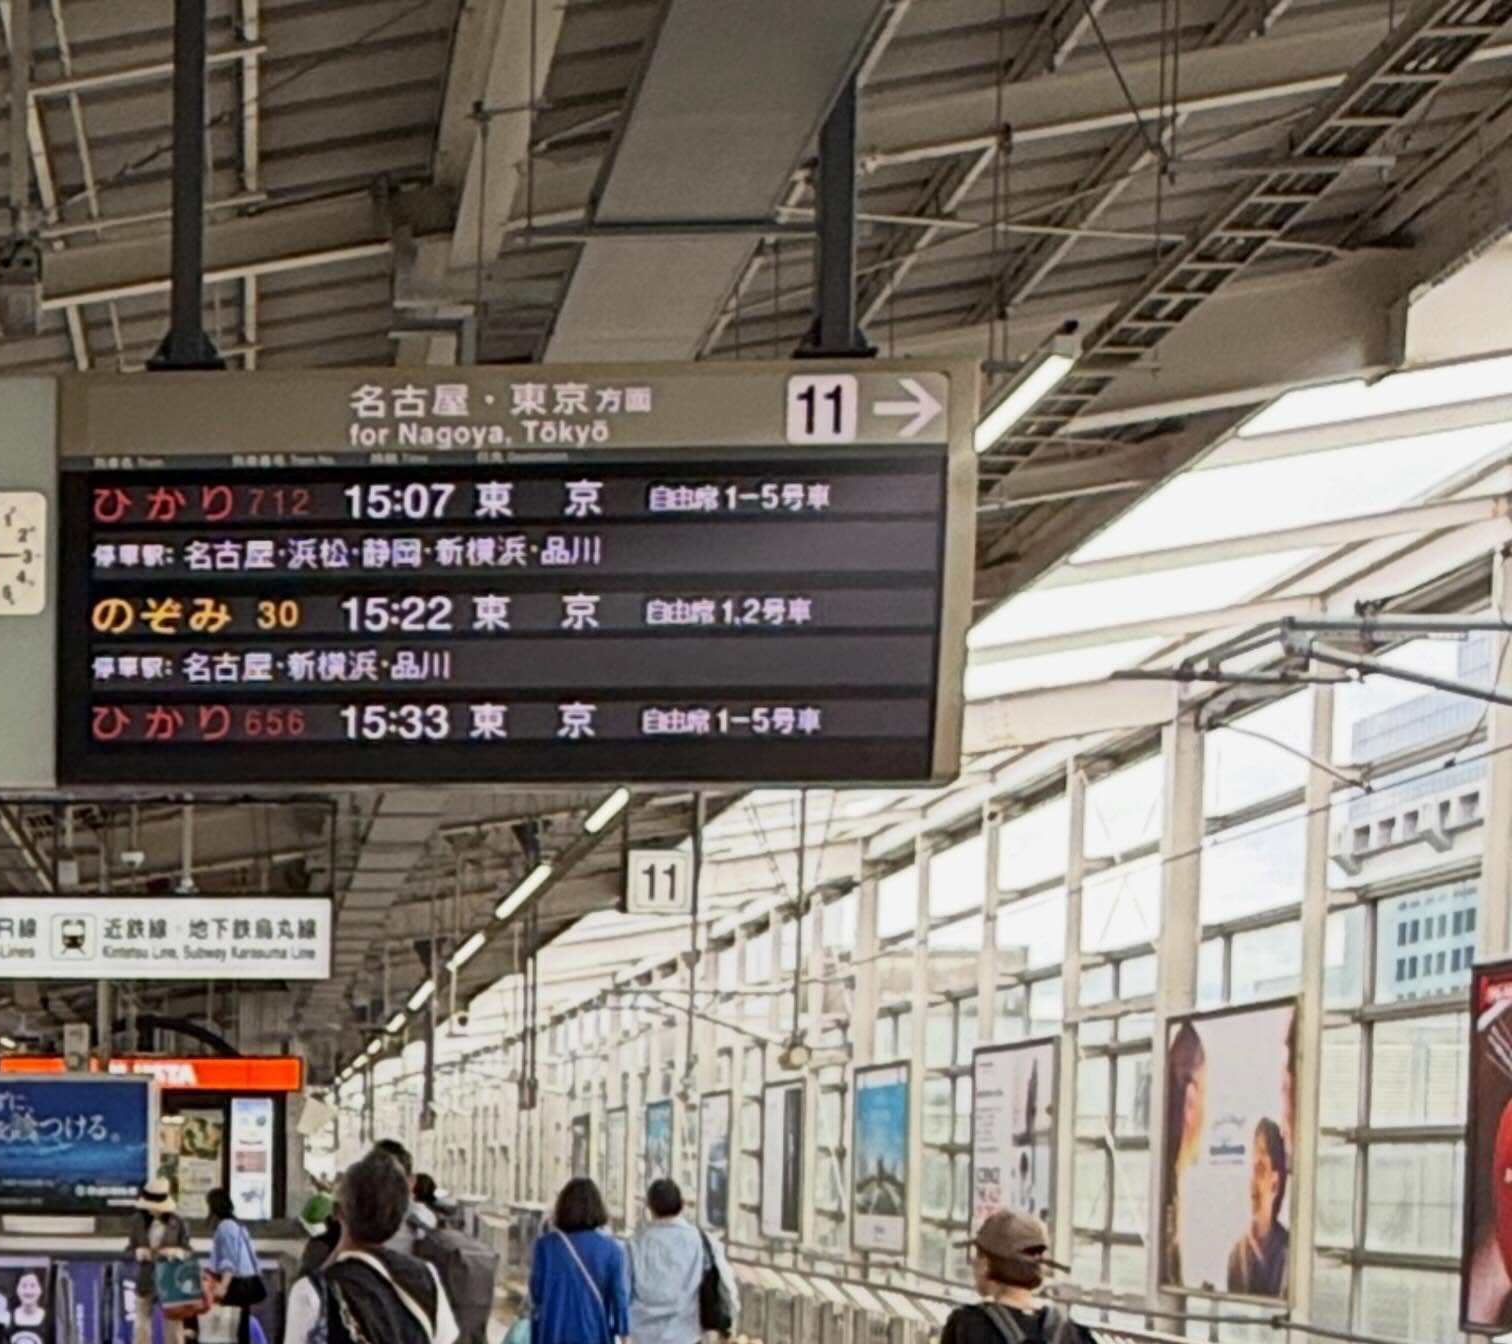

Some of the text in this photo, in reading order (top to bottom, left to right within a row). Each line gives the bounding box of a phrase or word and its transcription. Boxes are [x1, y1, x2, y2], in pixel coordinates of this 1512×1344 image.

[797, 385, 843, 434] 11
[350, 424, 388, 446] for
[398, 424, 513, 449] Nagoya,
[93, 486, 234, 521] ひかり
[249, 489, 310, 516] 712
[344, 483, 455, 518] 15:07
[92, 597, 232, 634] のぞみ
[256, 601, 299, 629] 30
[342, 596, 453, 631] 15:22
[92, 706, 230, 741] ひかり
[245, 709, 305, 735] 656
[341, 704, 450, 740] 15:33
[642, 864, 678, 900] 11
